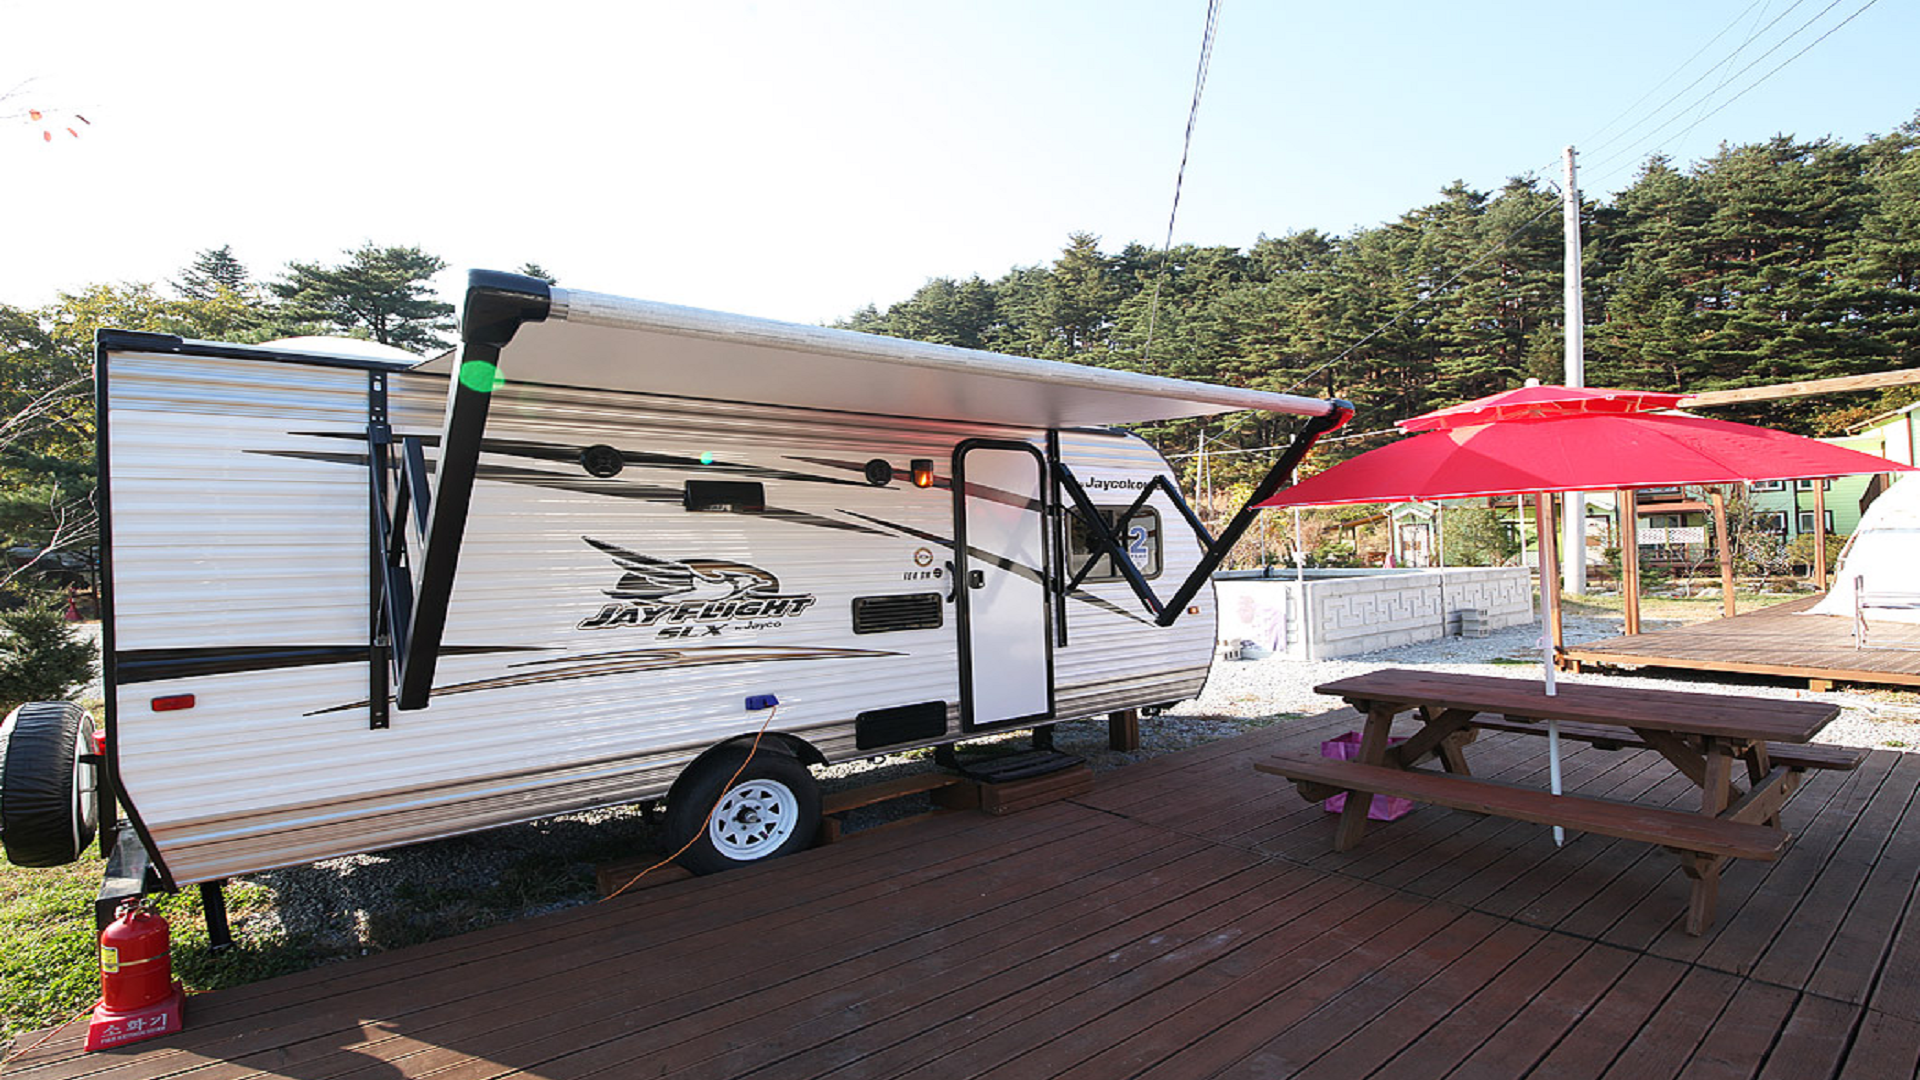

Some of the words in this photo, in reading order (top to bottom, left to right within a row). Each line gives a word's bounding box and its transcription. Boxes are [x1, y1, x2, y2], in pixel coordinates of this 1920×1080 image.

[1130, 527, 1146, 553] 2
[655, 624, 728, 640] SLX
[744, 620, 782, 631] Jayco
